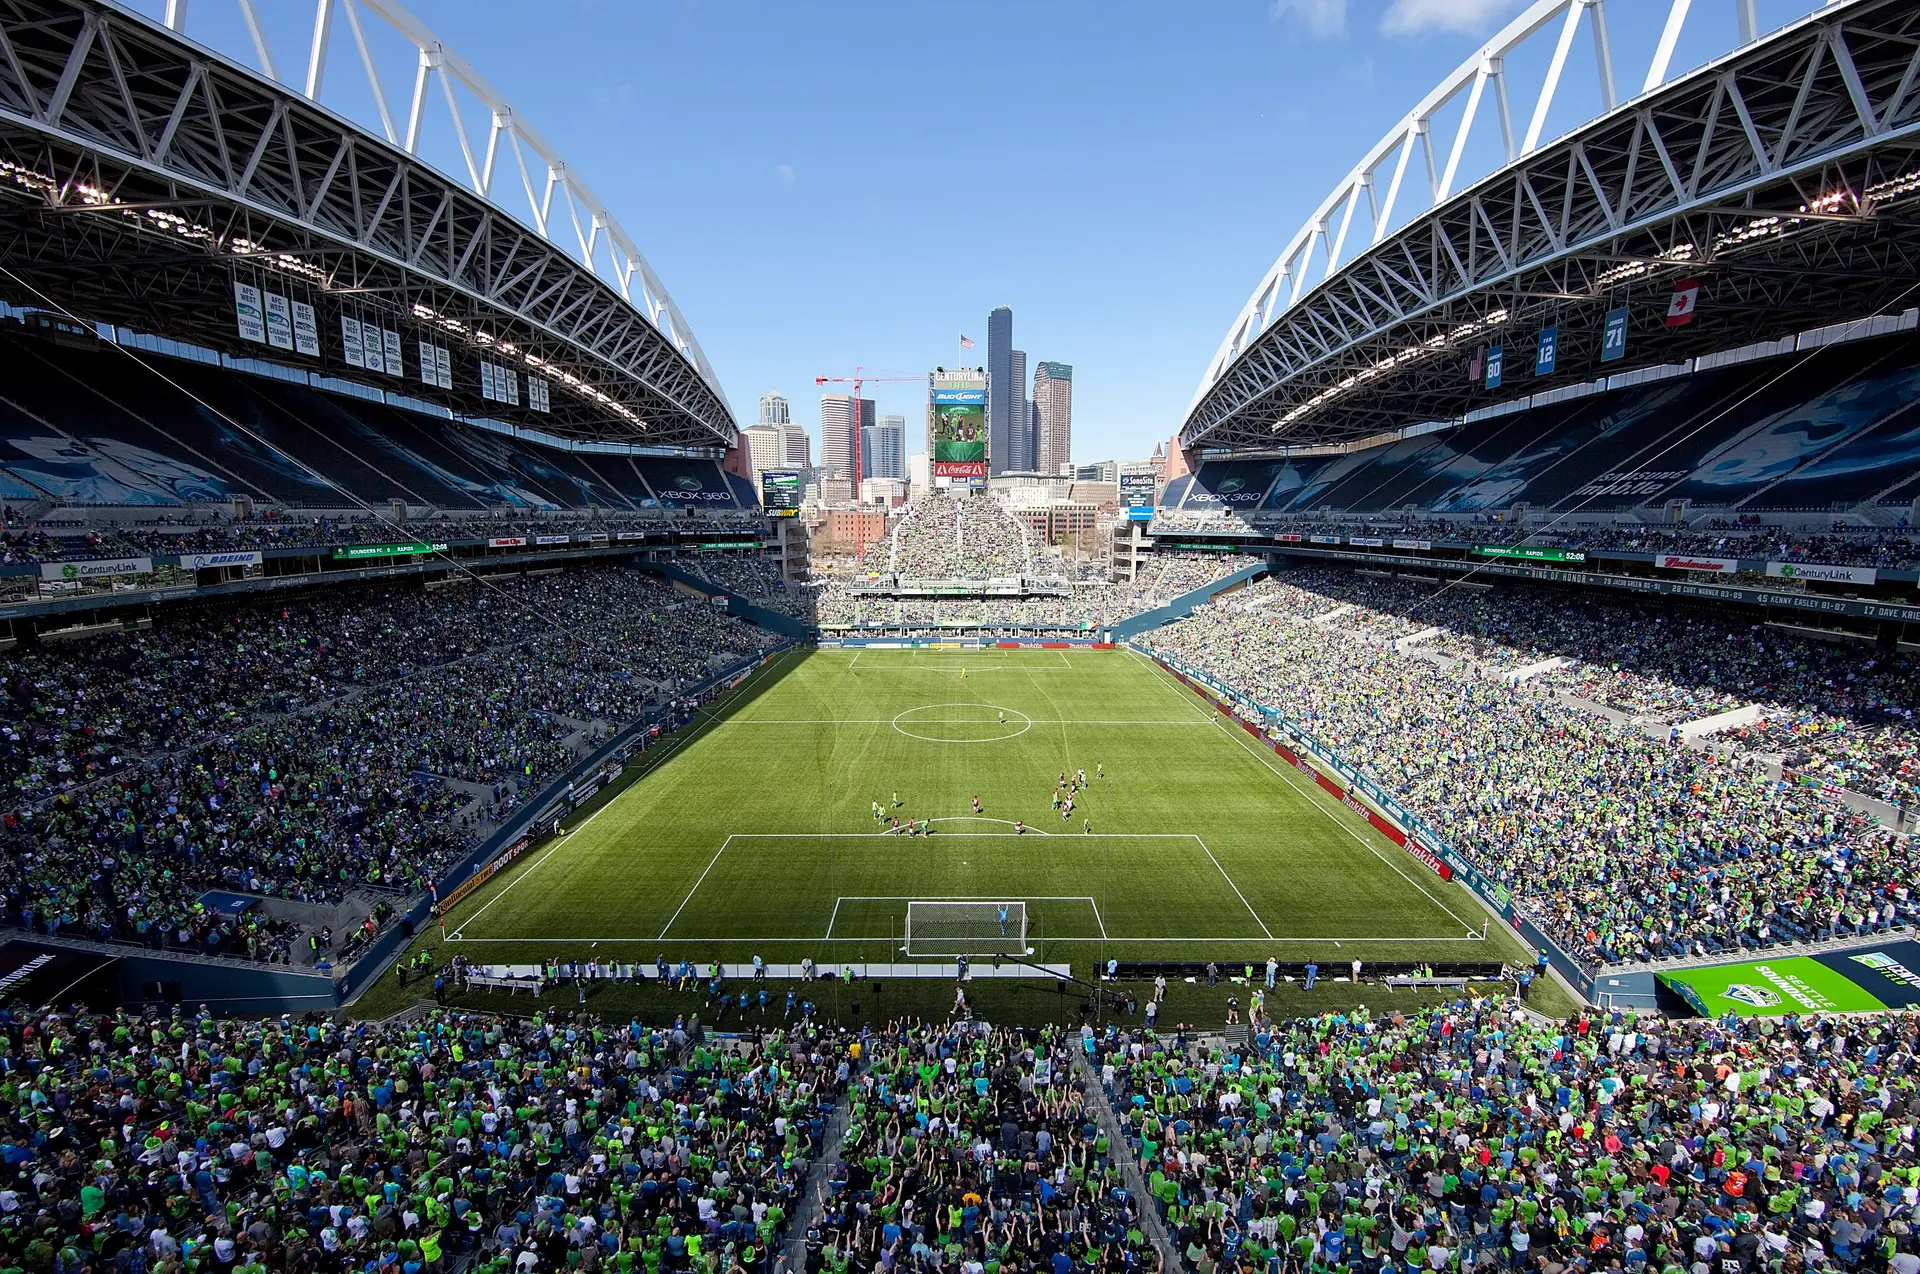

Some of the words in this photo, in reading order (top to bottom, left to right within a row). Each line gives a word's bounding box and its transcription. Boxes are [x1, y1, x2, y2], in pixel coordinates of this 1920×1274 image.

[242, 287, 254, 296] AFC
[240, 294, 256, 304] WEST
[271, 296, 282, 305] AFC
[270, 303, 284, 312] WEST
[298, 305, 308, 314] NFC
[296, 311, 311, 321] WEST
[240, 319, 263, 330] CHAMPS
[346, 320, 356, 328] NFC
[269, 327, 291, 338] CHAMPS
[346, 326, 358, 334] WEST
[296, 333, 317, 344] CHAMPS
[387, 339, 398, 347] WEST
[1606, 328, 1622, 348] 71
[345, 346, 362, 355] CHAMPS
[1539, 345, 1553, 364] 12
[1488, 362, 1500, 378] 80
[936, 371, 984, 381] CENTURYLINK
[1130, 477, 1153, 485] SonoSite
[657, 490, 701, 500] XBOX
[702, 492, 731, 500] 360
[1188, 493, 1231, 501] XBOX
[1231, 492, 1260, 500] 360
[210, 554, 254, 563] BOEING
[1566, 552, 1584, 560] 52:08
[81, 562, 137, 574] CenturyLink
[1664, 557, 1723, 570] Budweiser
[1532, 570, 1547, 580] RING
[1551, 572, 1559, 580] OF
[1562, 573, 1586, 583] HONOR
[1794, 567, 1853, 580] CenturyLink
[1683, 586, 1696, 594] CURT
[1698, 588, 1719, 596] WARNER
[1720, 591, 1742, 599] 83-89
[1757, 594, 1768, 603] 45
[1770, 596, 1792, 605] KENNY
[1794, 598, 1819, 608] EASLEY
[1822, 602, 1846, 611] 81-87
[1864, 606, 1874, 615] 17
[1879, 608, 1898, 618] DAVE
[493, 849, 513, 871] ROOT
[440, 880, 475, 911] Continental
[480, 867, 493, 881] TIRE
[1876, 968, 1907, 984] FIELD
[1755, 966, 1821, 1009] SOUNDERS
[1785, 975, 1836, 1007] SEATTLE
